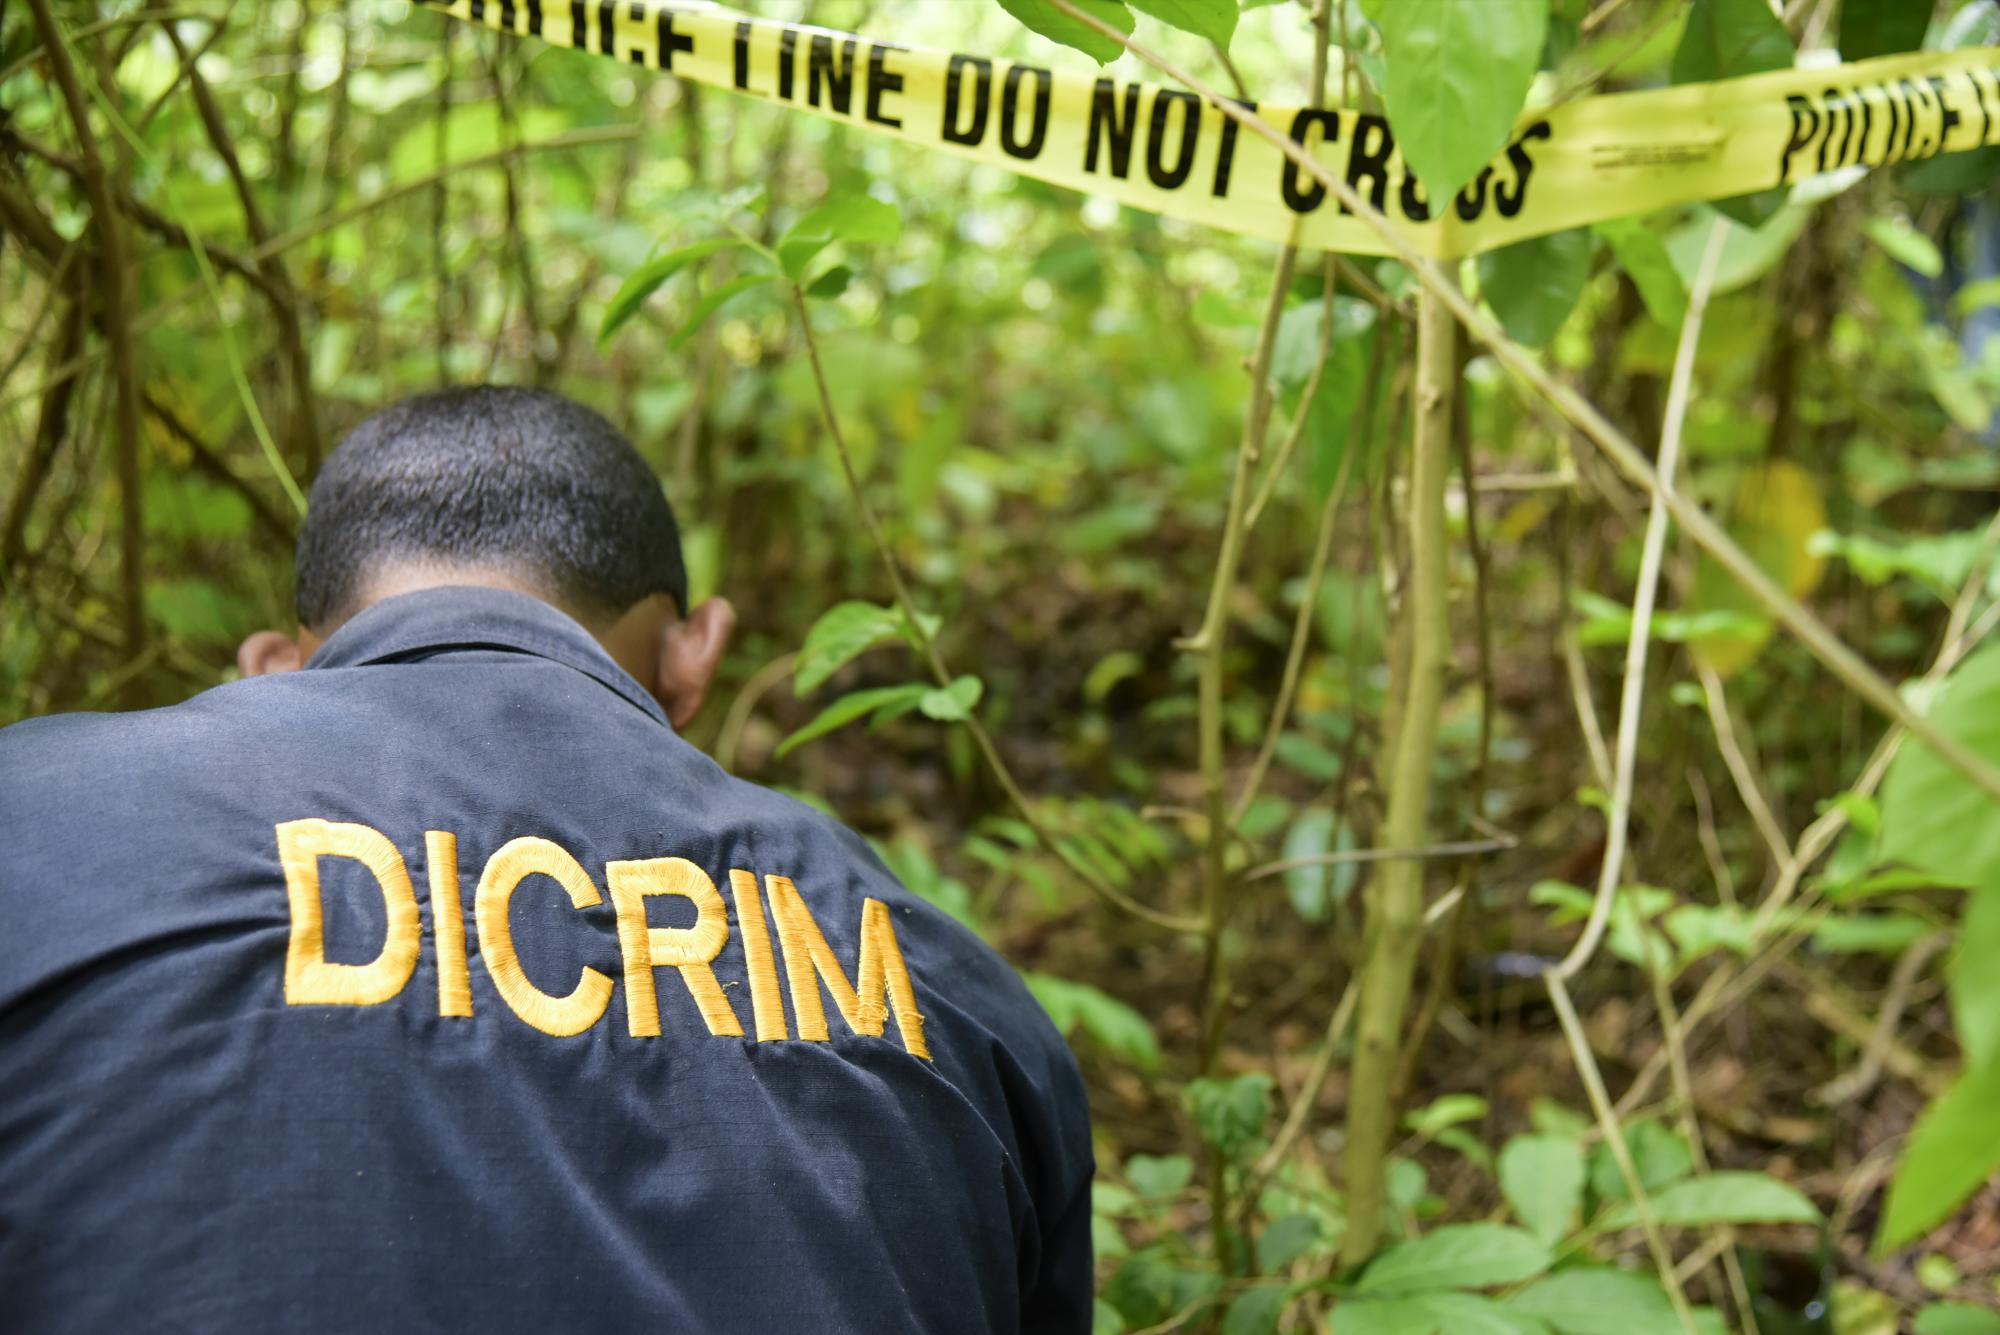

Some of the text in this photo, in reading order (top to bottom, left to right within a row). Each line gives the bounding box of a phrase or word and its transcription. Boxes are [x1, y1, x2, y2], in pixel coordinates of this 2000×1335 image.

[734, 20, 909, 130] LINE
[941, 54, 1052, 160] DO
[1084, 77, 1258, 198] NOT
[275, 817, 933, 1062] DICRIM
